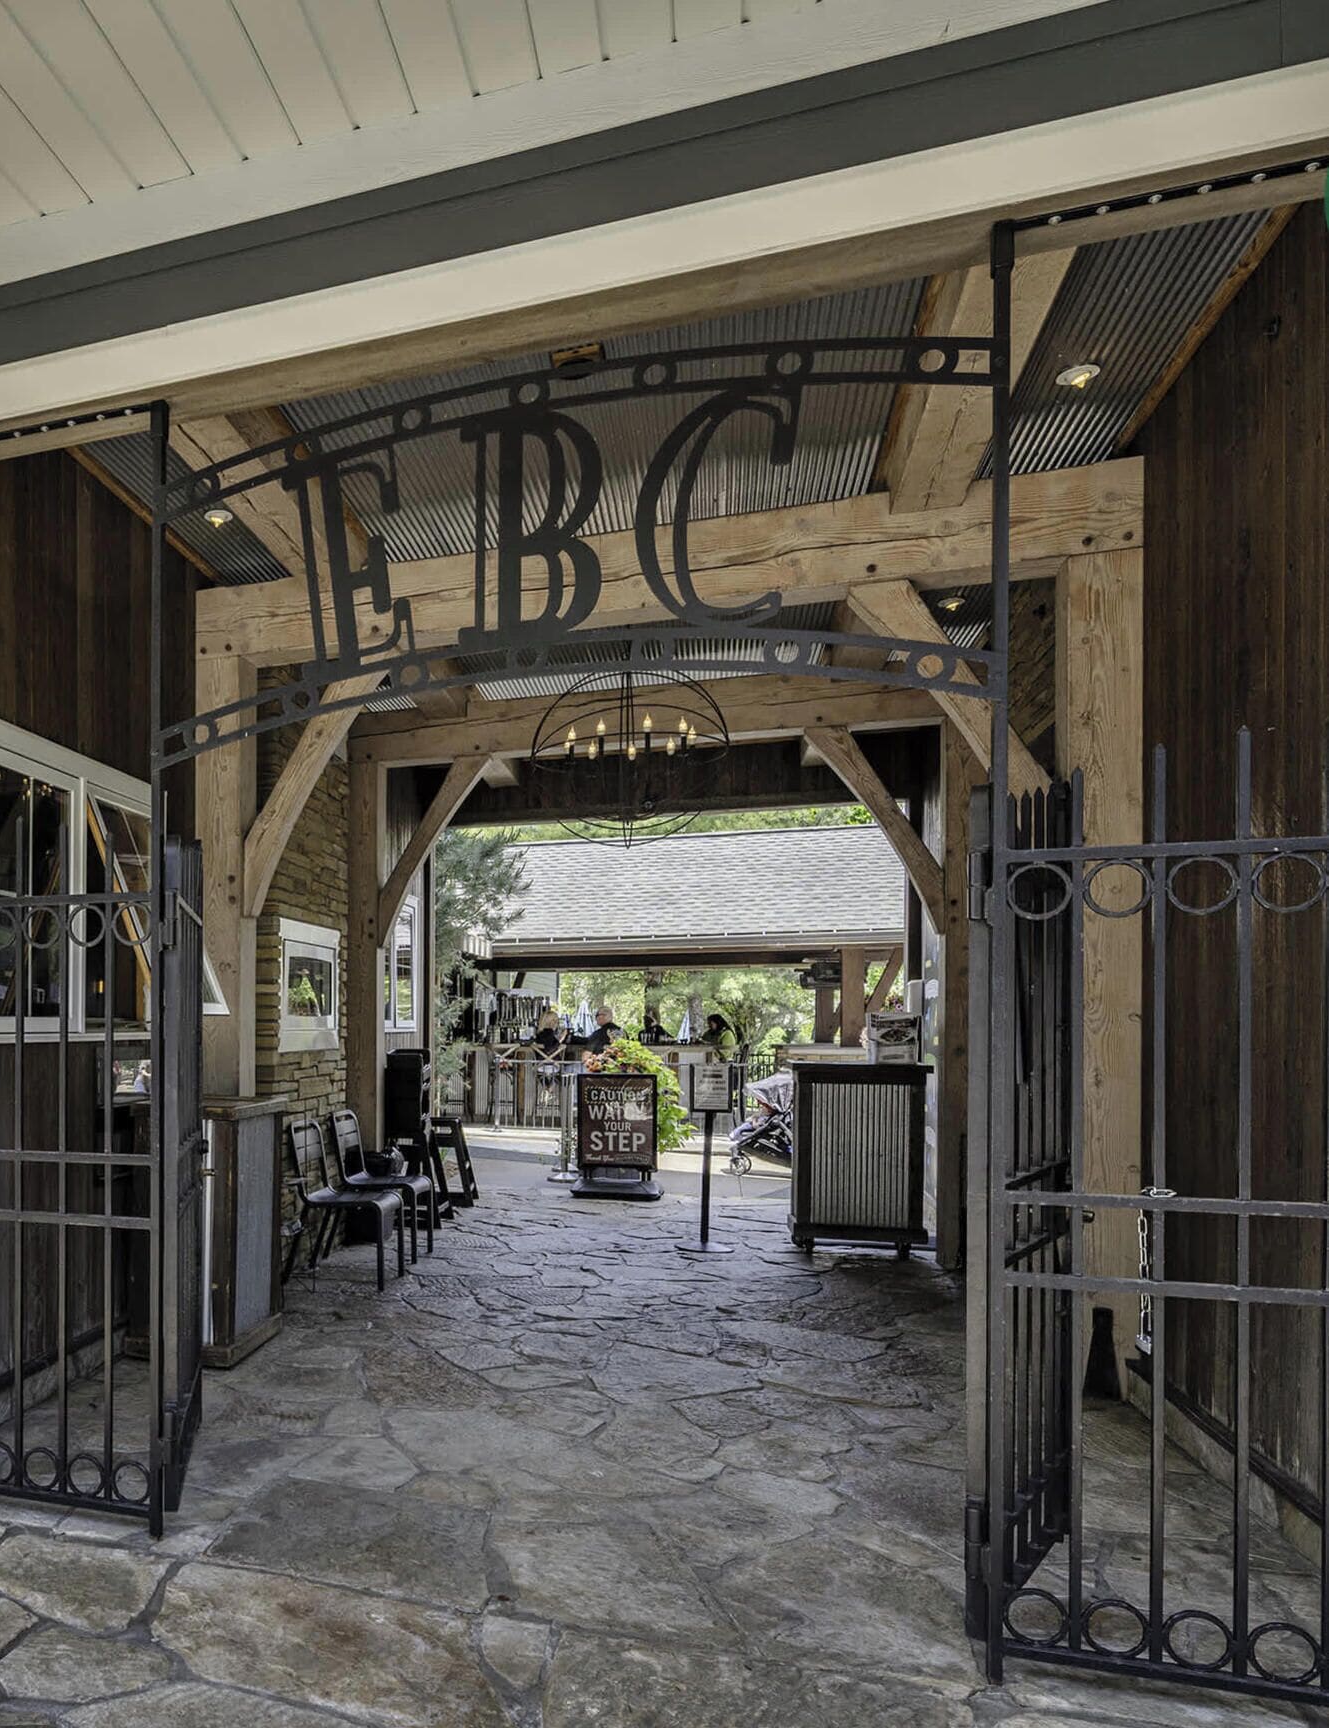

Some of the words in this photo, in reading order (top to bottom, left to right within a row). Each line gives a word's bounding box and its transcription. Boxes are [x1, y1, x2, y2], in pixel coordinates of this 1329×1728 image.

[282, 382, 803, 680] EBC
[590, 1090, 647, 1101] CAUTION
[604, 1121, 632, 1132] YOUR
[590, 1131, 646, 1152] STEP
